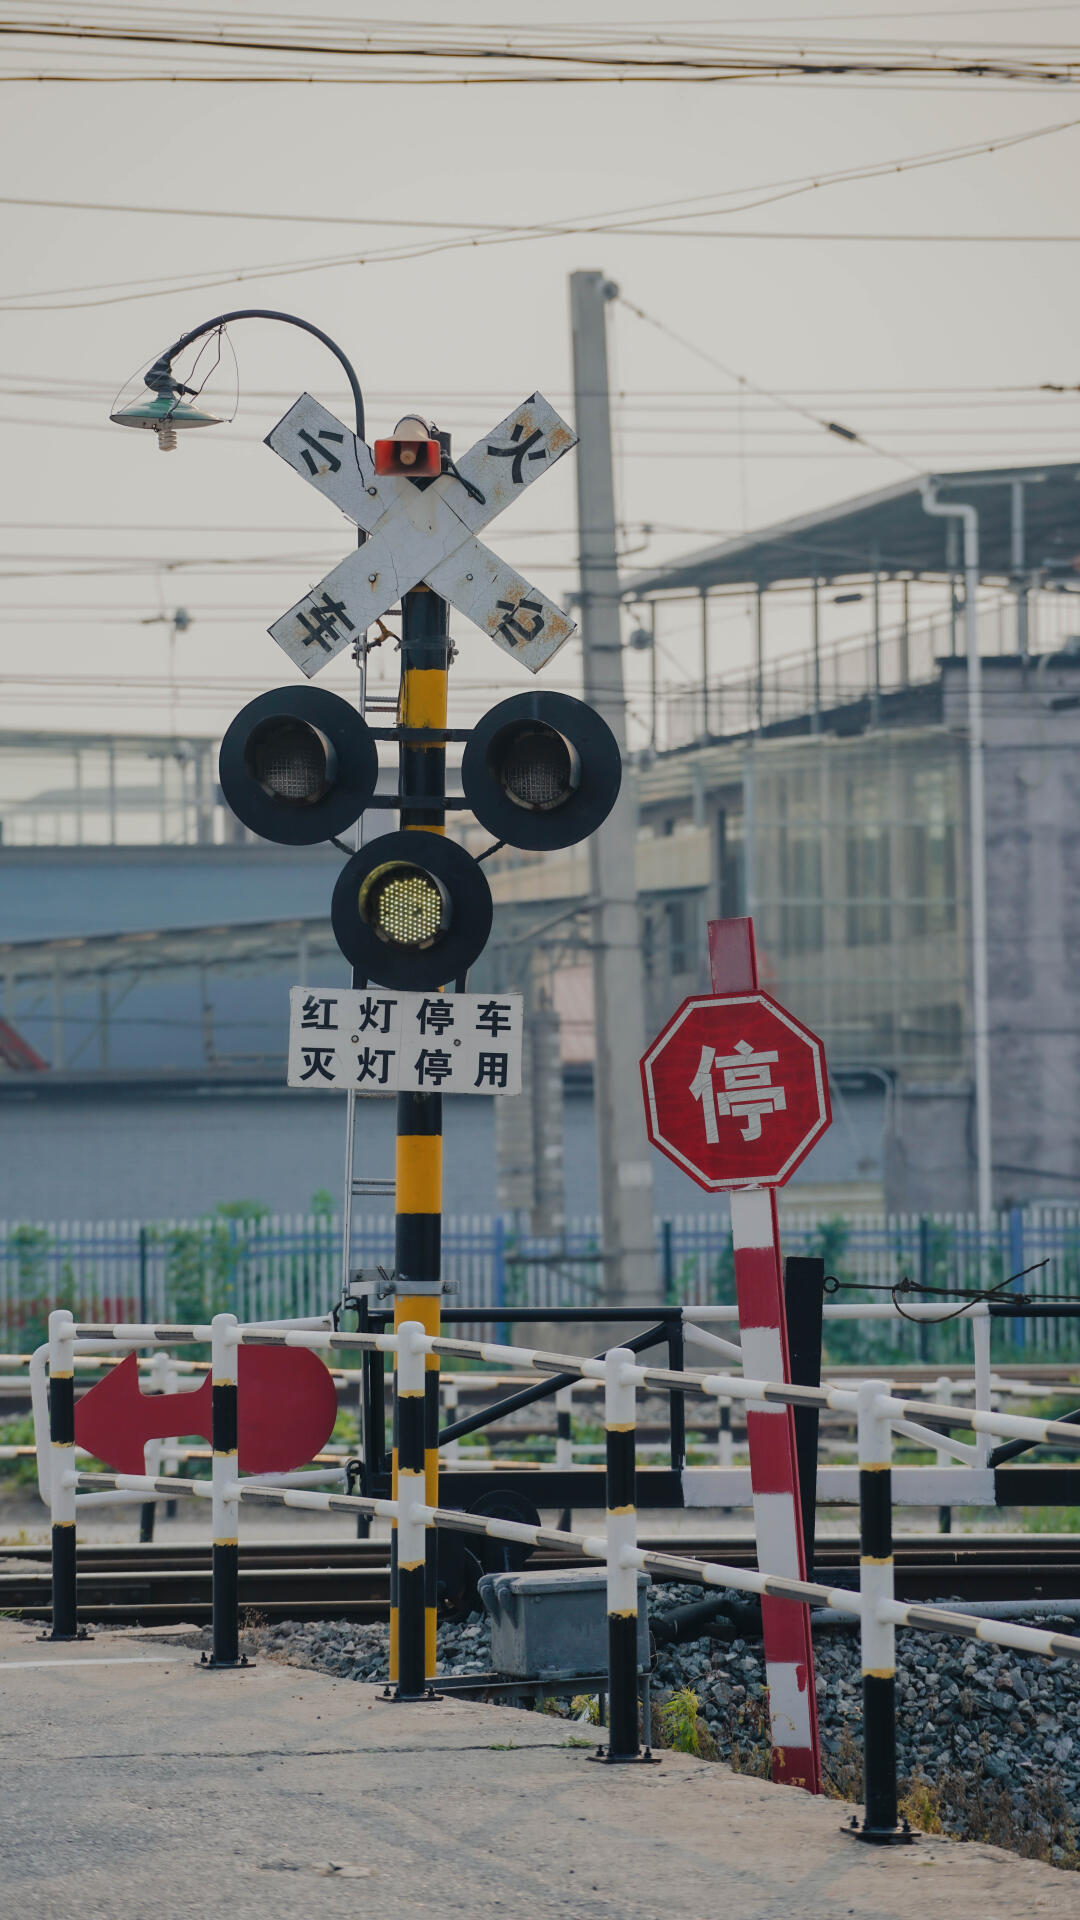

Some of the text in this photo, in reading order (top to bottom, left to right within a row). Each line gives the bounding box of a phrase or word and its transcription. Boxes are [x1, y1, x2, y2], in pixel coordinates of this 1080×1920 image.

[298, 428, 343, 476] 小
[487, 424, 546, 483] 火
[496, 598, 545, 647] 心
[301, 995, 512, 1037] 红灯停车
[300, 1047, 508, 1088] 灭灯停用
[688, 1039, 787, 1144] 停
